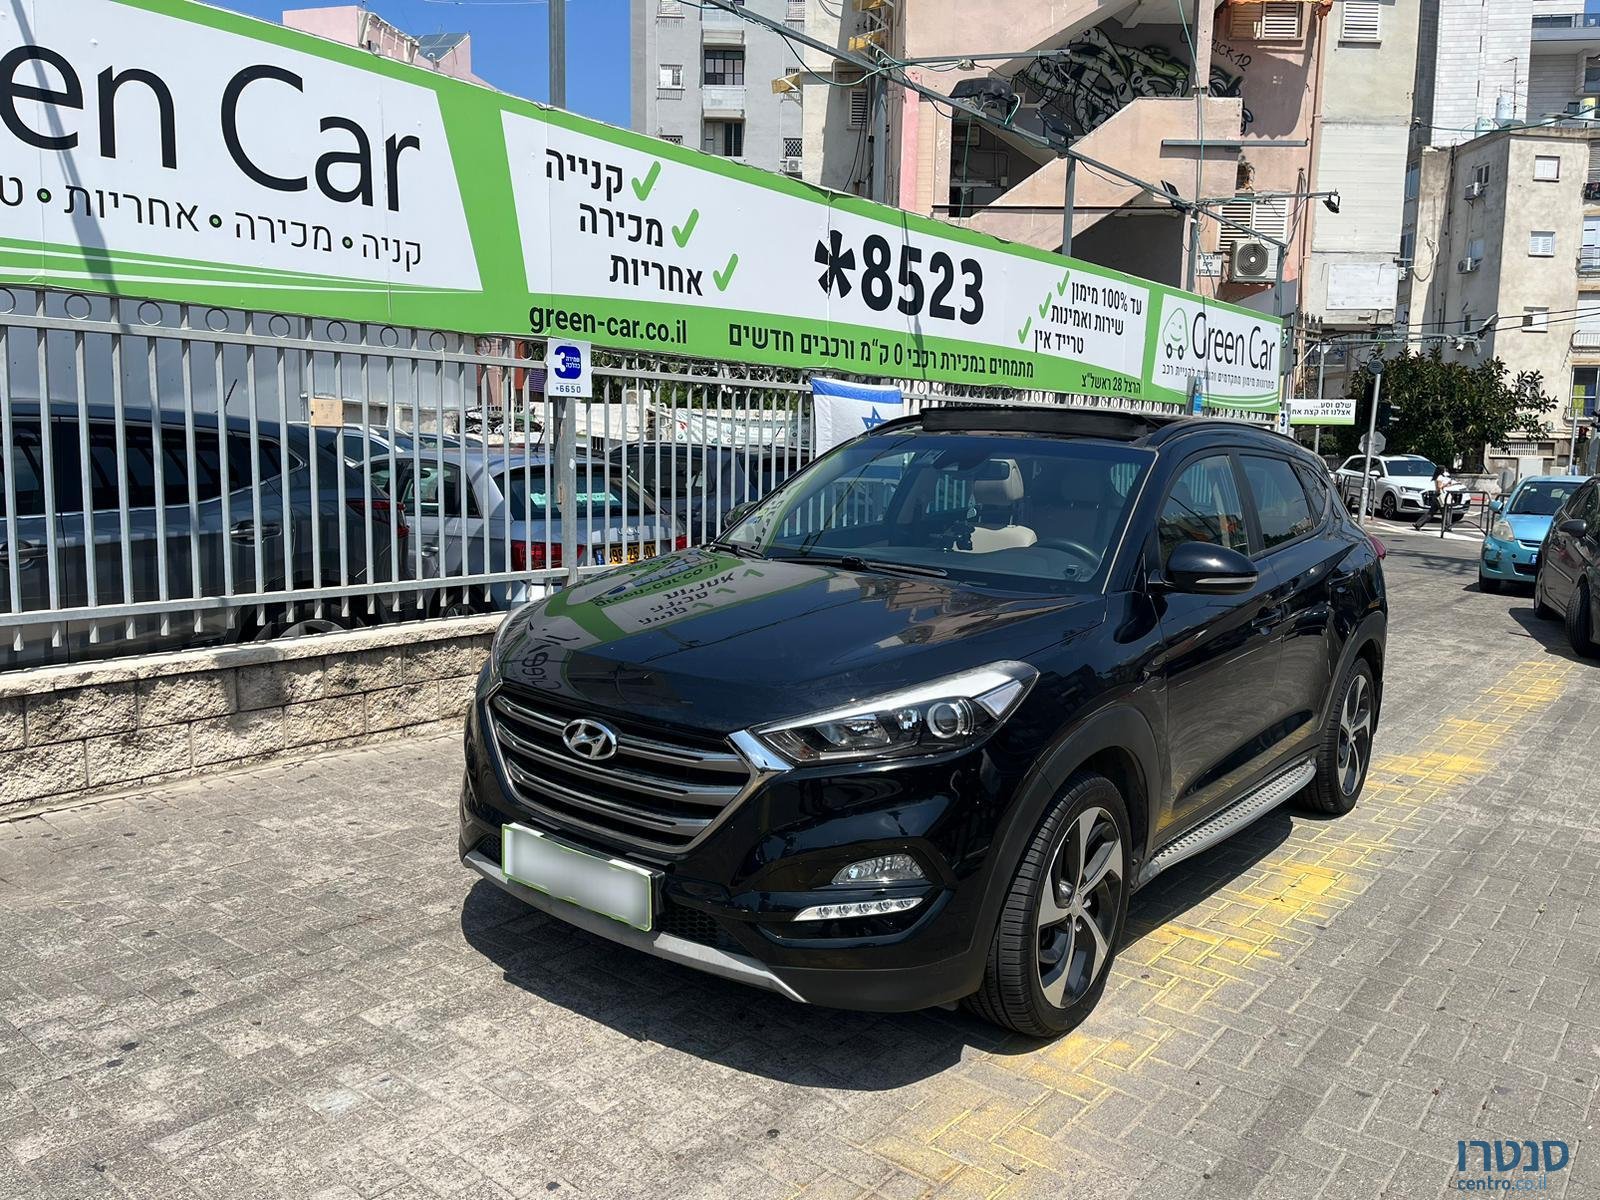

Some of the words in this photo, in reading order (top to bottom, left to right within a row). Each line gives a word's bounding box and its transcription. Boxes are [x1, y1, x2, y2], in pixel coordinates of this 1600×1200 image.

[221, 64, 421, 212] Car
[546, 148, 624, 202] קנייה
[63, 185, 200, 232] אחריות
[235, 211, 333, 252] מכירה
[580, 203, 664, 247] מכירה
[362, 233, 422, 272] קניה
[609, 254, 703, 297] אחריות
[1071, 281, 1099, 305] מימון
[1101, 288, 1128, 312] 100%
[1050, 304, 1092, 330] ואמינות
[1130, 298, 1142, 315] עד
[529, 306, 687, 344] green-car.co.il
[1094, 314, 1124, 336] שירות
[728, 323, 795, 353] חדשים
[800, 332, 855, 360] ורכבים
[1034, 329, 1052, 353] אין
[1054, 333, 1084, 354] טרייד
[1191, 312, 1246, 366] Green
[1249, 326, 1276, 372] Car
[893, 342, 903, 366] 0
[907, 348, 937, 369] רכבי
[940, 353, 986, 374] במכירת
[989, 357, 1034, 378] מתמחים
[1161, 363, 1174, 375] רכב
[1113, 376, 1123, 391] 28
[1124, 378, 1141, 394] הרצל
[1331, 408, 1351, 416] אצלנו
